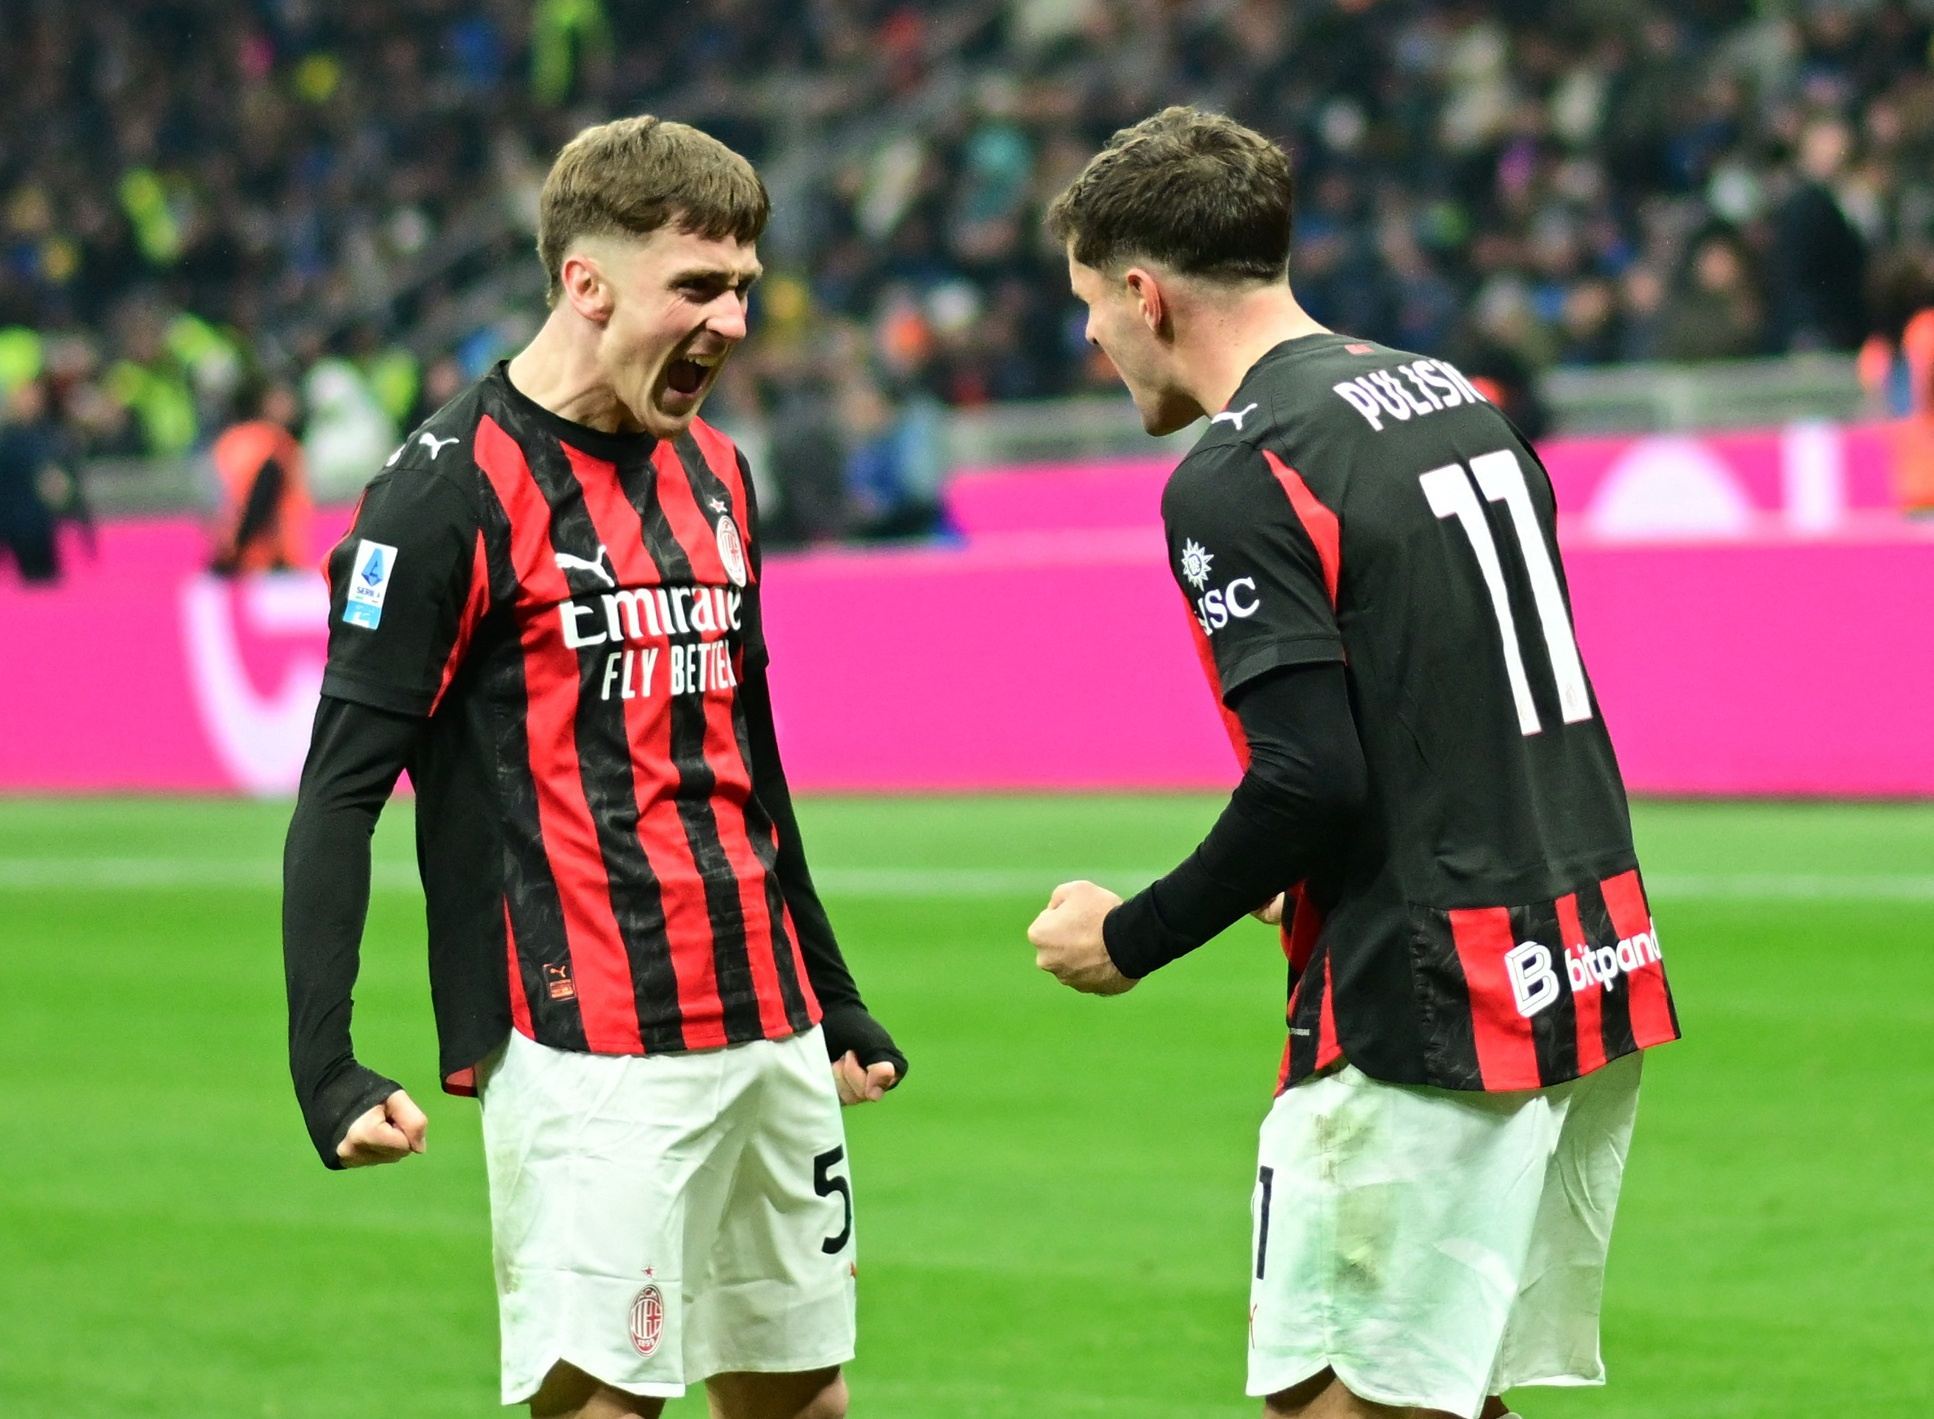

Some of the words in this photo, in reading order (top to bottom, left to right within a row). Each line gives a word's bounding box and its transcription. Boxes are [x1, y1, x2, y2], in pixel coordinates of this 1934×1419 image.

[559, 586, 742, 650] Emirate
[1419, 449, 1593, 736] 11
[601, 648, 660, 700] FLY
[1504, 940, 1560, 1018] B
[814, 1143, 853, 1255] 5
